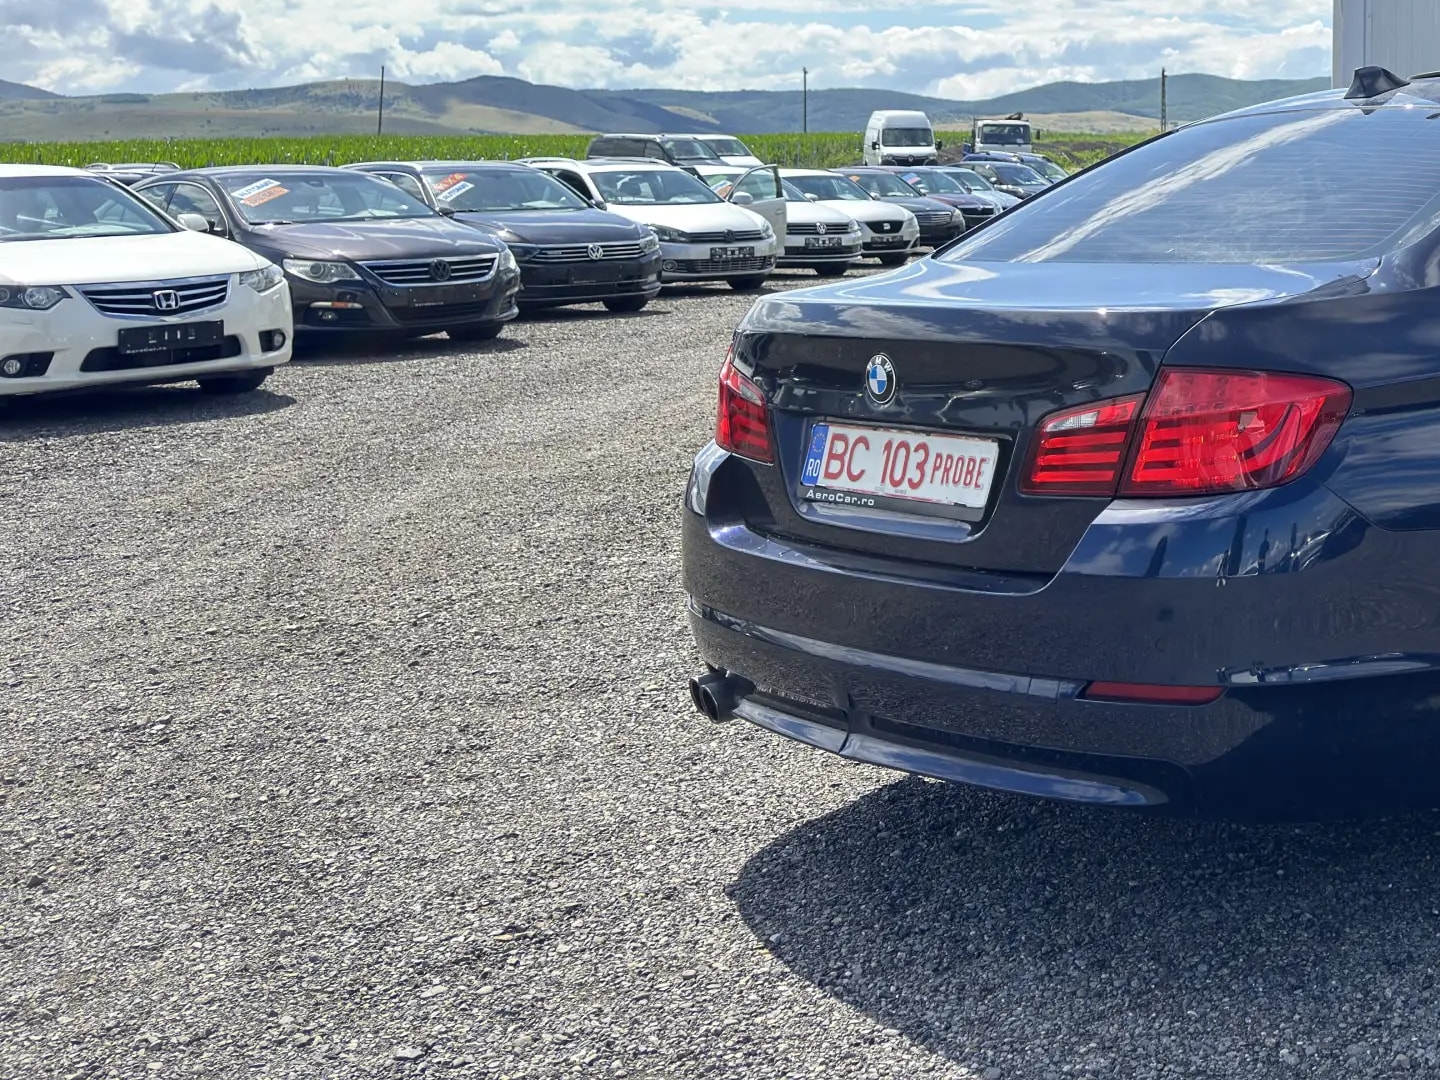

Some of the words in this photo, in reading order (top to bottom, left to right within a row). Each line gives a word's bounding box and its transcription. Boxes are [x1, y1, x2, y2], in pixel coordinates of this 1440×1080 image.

[806, 458, 820, 477] RO
[823, 432, 870, 482] BC
[880, 438, 930, 490] 103
[930, 452, 986, 489] PROBE
[806, 489, 875, 506] AeroCar.ro
